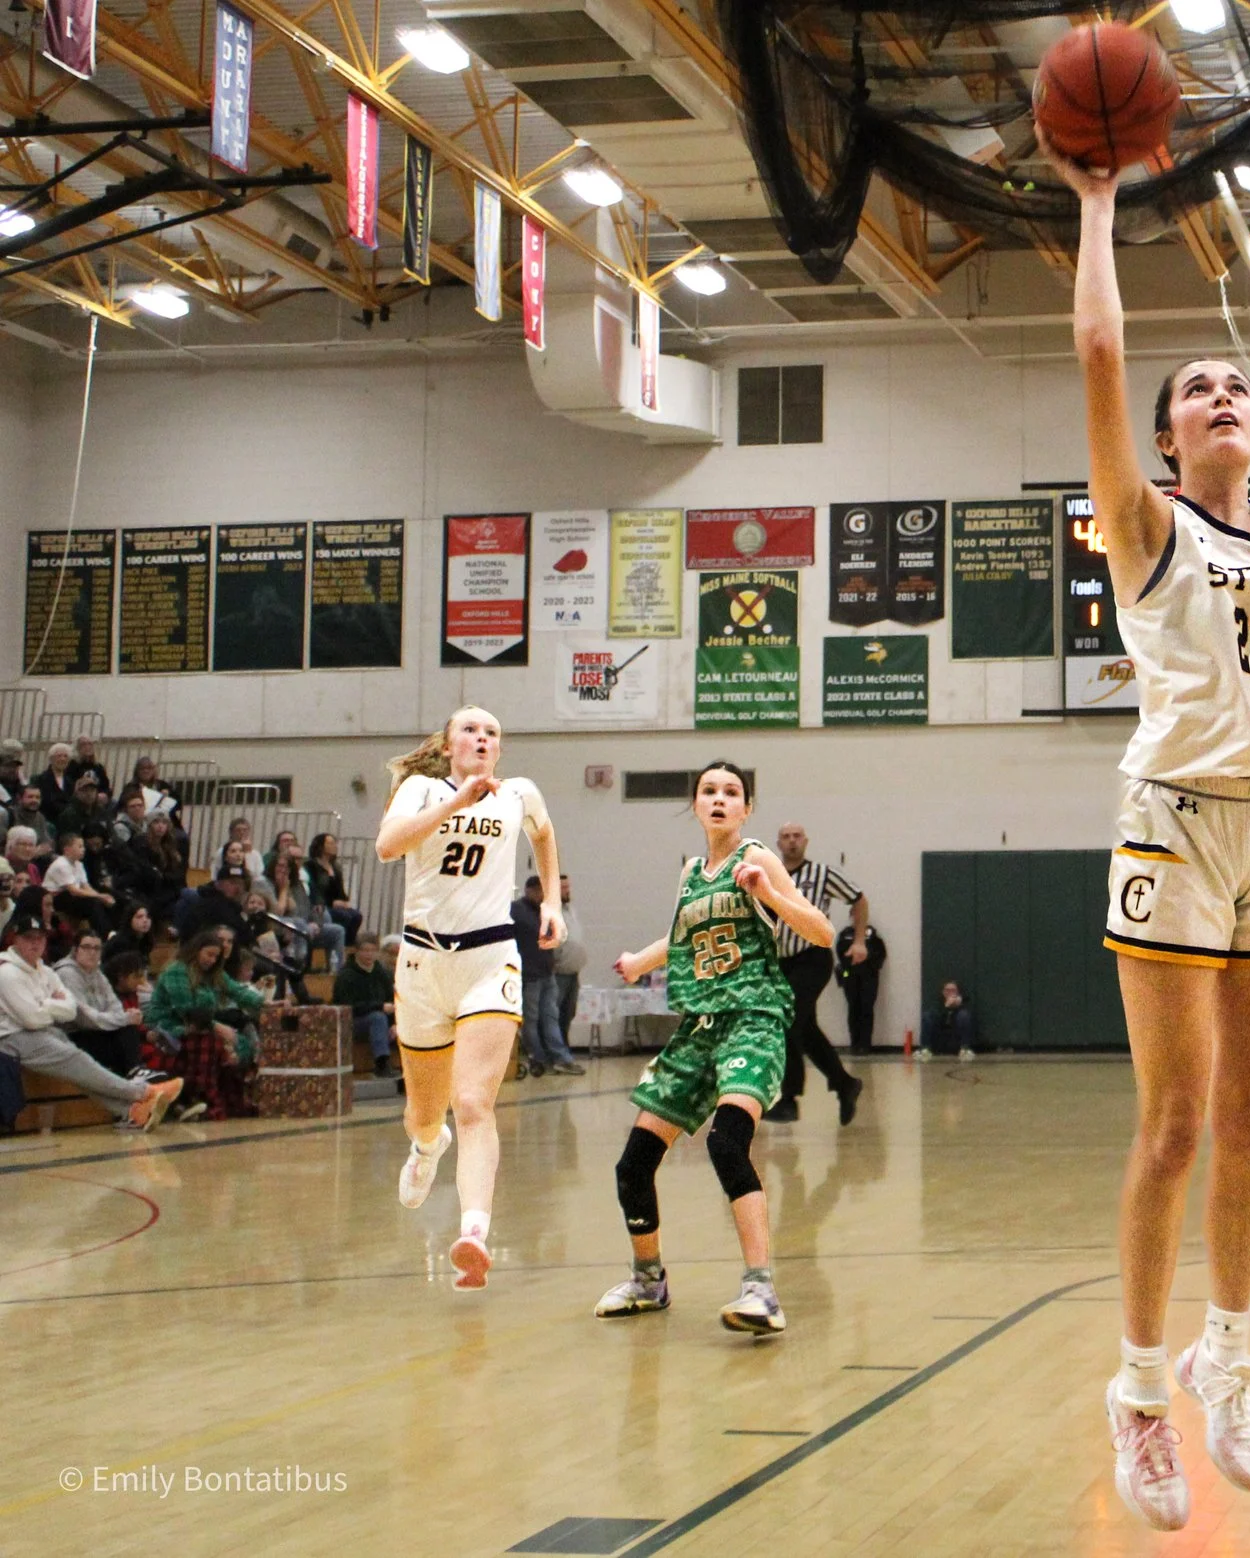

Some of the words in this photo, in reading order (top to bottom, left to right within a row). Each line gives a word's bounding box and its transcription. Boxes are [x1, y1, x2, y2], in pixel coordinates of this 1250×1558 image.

[965, 508, 1007, 519] OXFORD
[849, 514, 865, 533] G
[964, 519, 1040, 531] BASKETBALL
[953, 539, 976, 548] 1000
[980, 538, 1006, 547] POINT
[1009, 537, 1051, 546] SCORERS
[221, 553, 237, 562] 100
[240, 552, 275, 561] CAREER
[278, 551, 303, 560] WINS
[332, 549, 360, 558] MATCH
[362, 548, 400, 556] WINNERS
[32, 558, 47, 567] 100
[86, 557, 111, 566] WINS
[126, 556, 142, 565] 100
[145, 555, 179, 564] CAREER
[182, 554, 205, 562] WINS
[899, 560, 934, 568] FLEMING
[955, 563, 987, 571] Andrew
[723, 572, 750, 586] MAINE
[752, 572, 797, 593] SOFTBALL
[839, 593, 858, 602] 2021
[866, 592, 877, 601] 22
[1090, 602, 1099, 626] 1
[705, 635, 743, 647] Jessie
[748, 634, 791, 646] Becher
[1075, 637, 1099, 649] won
[573, 653, 612, 664] PARENTS
[573, 672, 603, 685] LOSE
[698, 673, 721, 683] CAM
[725, 672, 798, 683] LETOURNEAU
[827, 675, 863, 684] ALEXIS
[866, 674, 924, 683] McCORMICK
[580, 687, 609, 700] MOST
[723, 693, 752, 701] STATE
[754, 692, 785, 701] CLASS
[788, 692, 795, 700] A
[853, 692, 882, 700] STATE
[884, 692, 914, 700] CLASS
[917, 691, 924, 699] A
[738, 712, 757, 720] GOLF
[759, 711, 798, 719] CHAMPION
[867, 709, 886, 717] GOLF
[440, 816, 502, 837] STAGS
[439, 842, 486, 877] 20
[692, 923, 742, 981] 25
